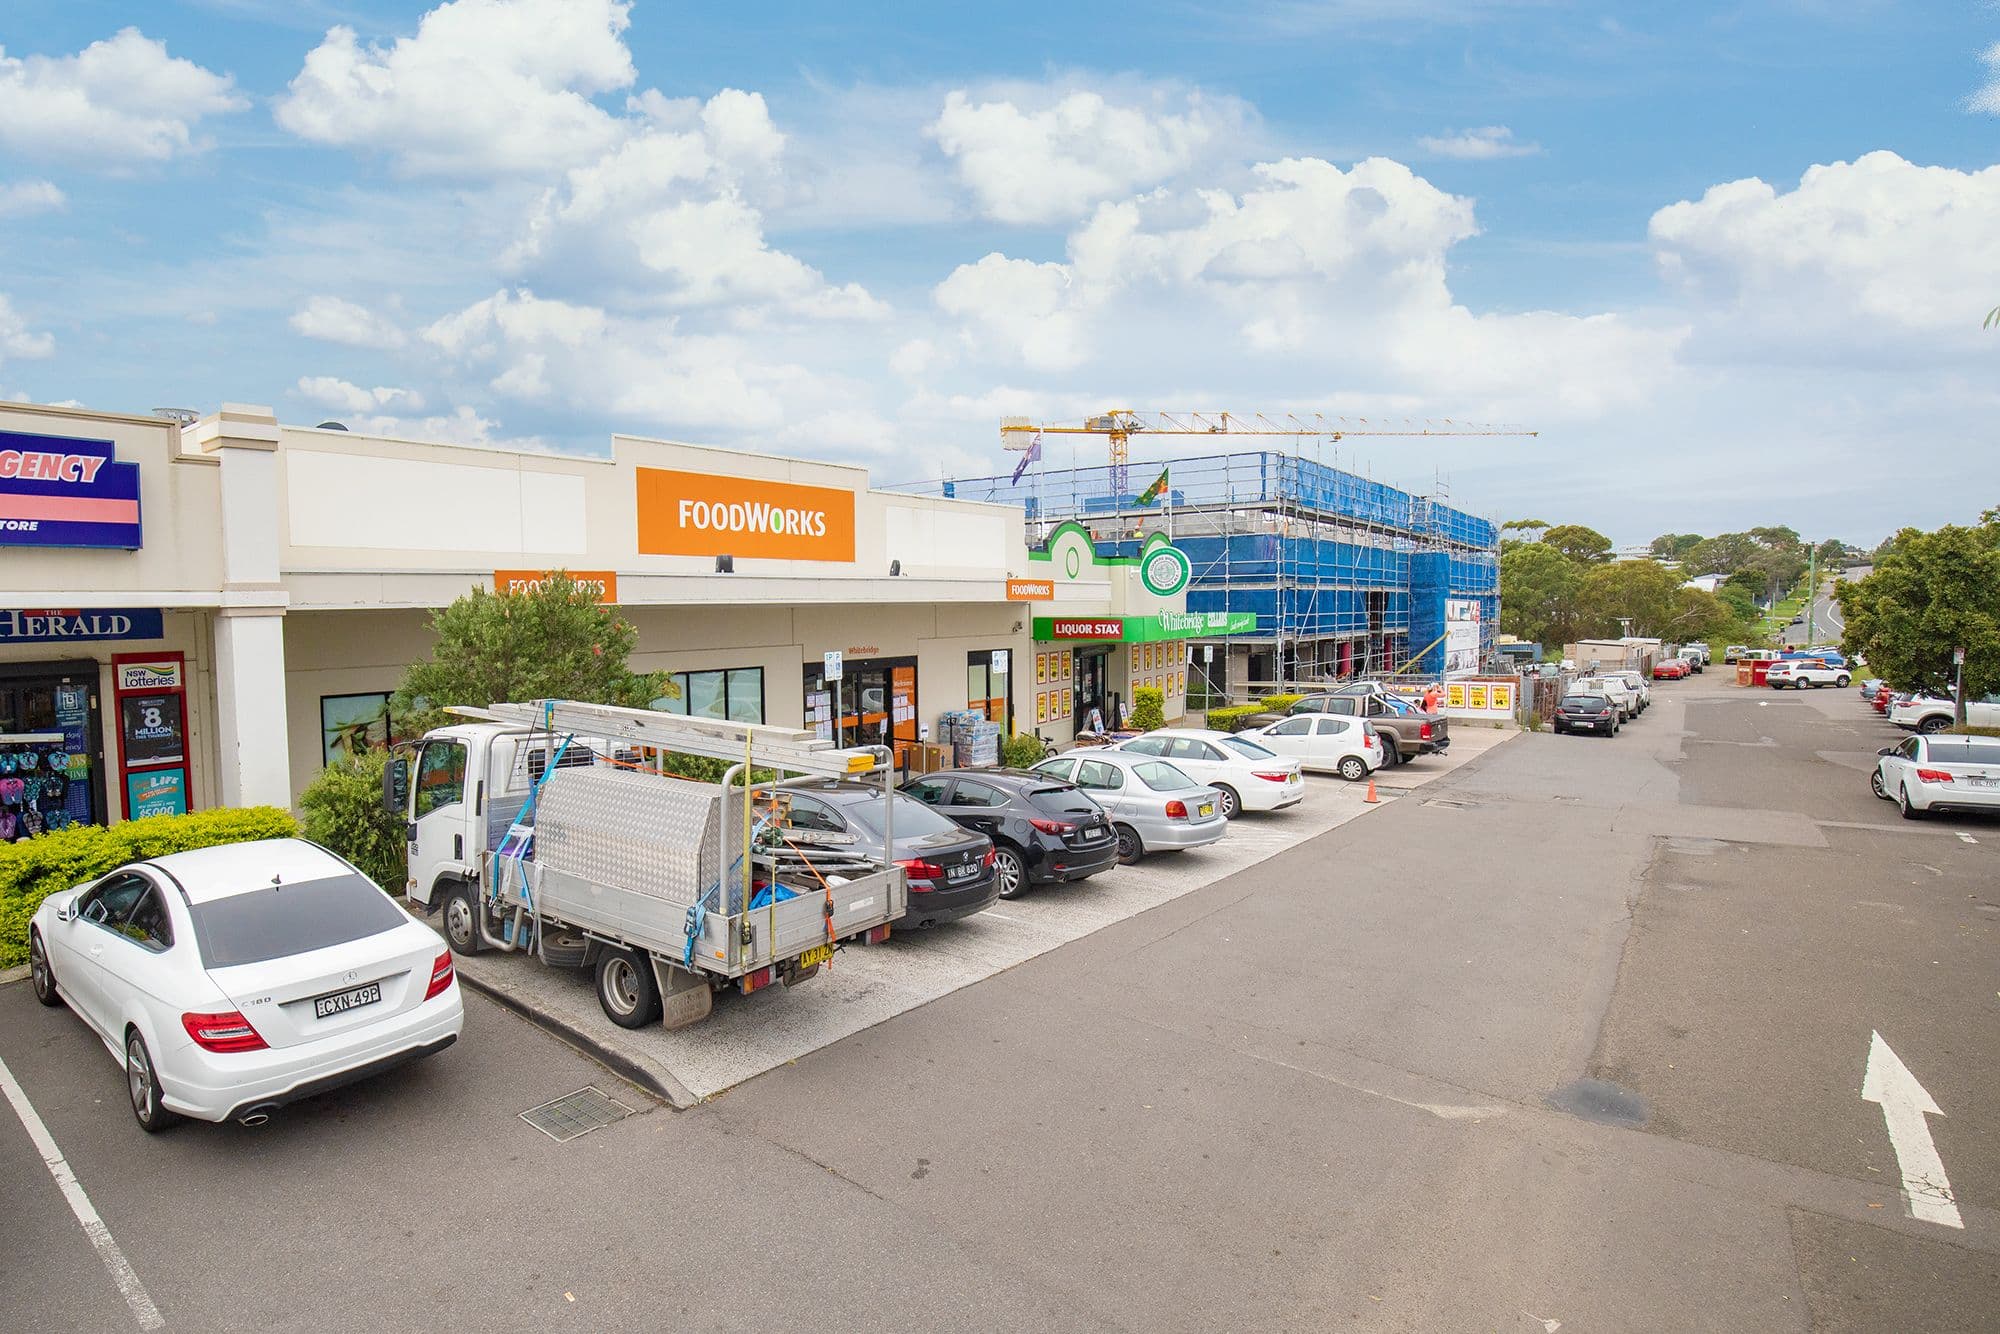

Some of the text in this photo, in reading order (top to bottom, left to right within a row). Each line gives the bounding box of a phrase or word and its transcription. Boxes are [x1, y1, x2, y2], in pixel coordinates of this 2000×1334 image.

[0, 610, 131, 638] HERALD
[1056, 624, 1120, 635] LIQUOR STAX
[125, 676, 175, 687] Lotteries
[135, 726, 172, 736] MILLION
